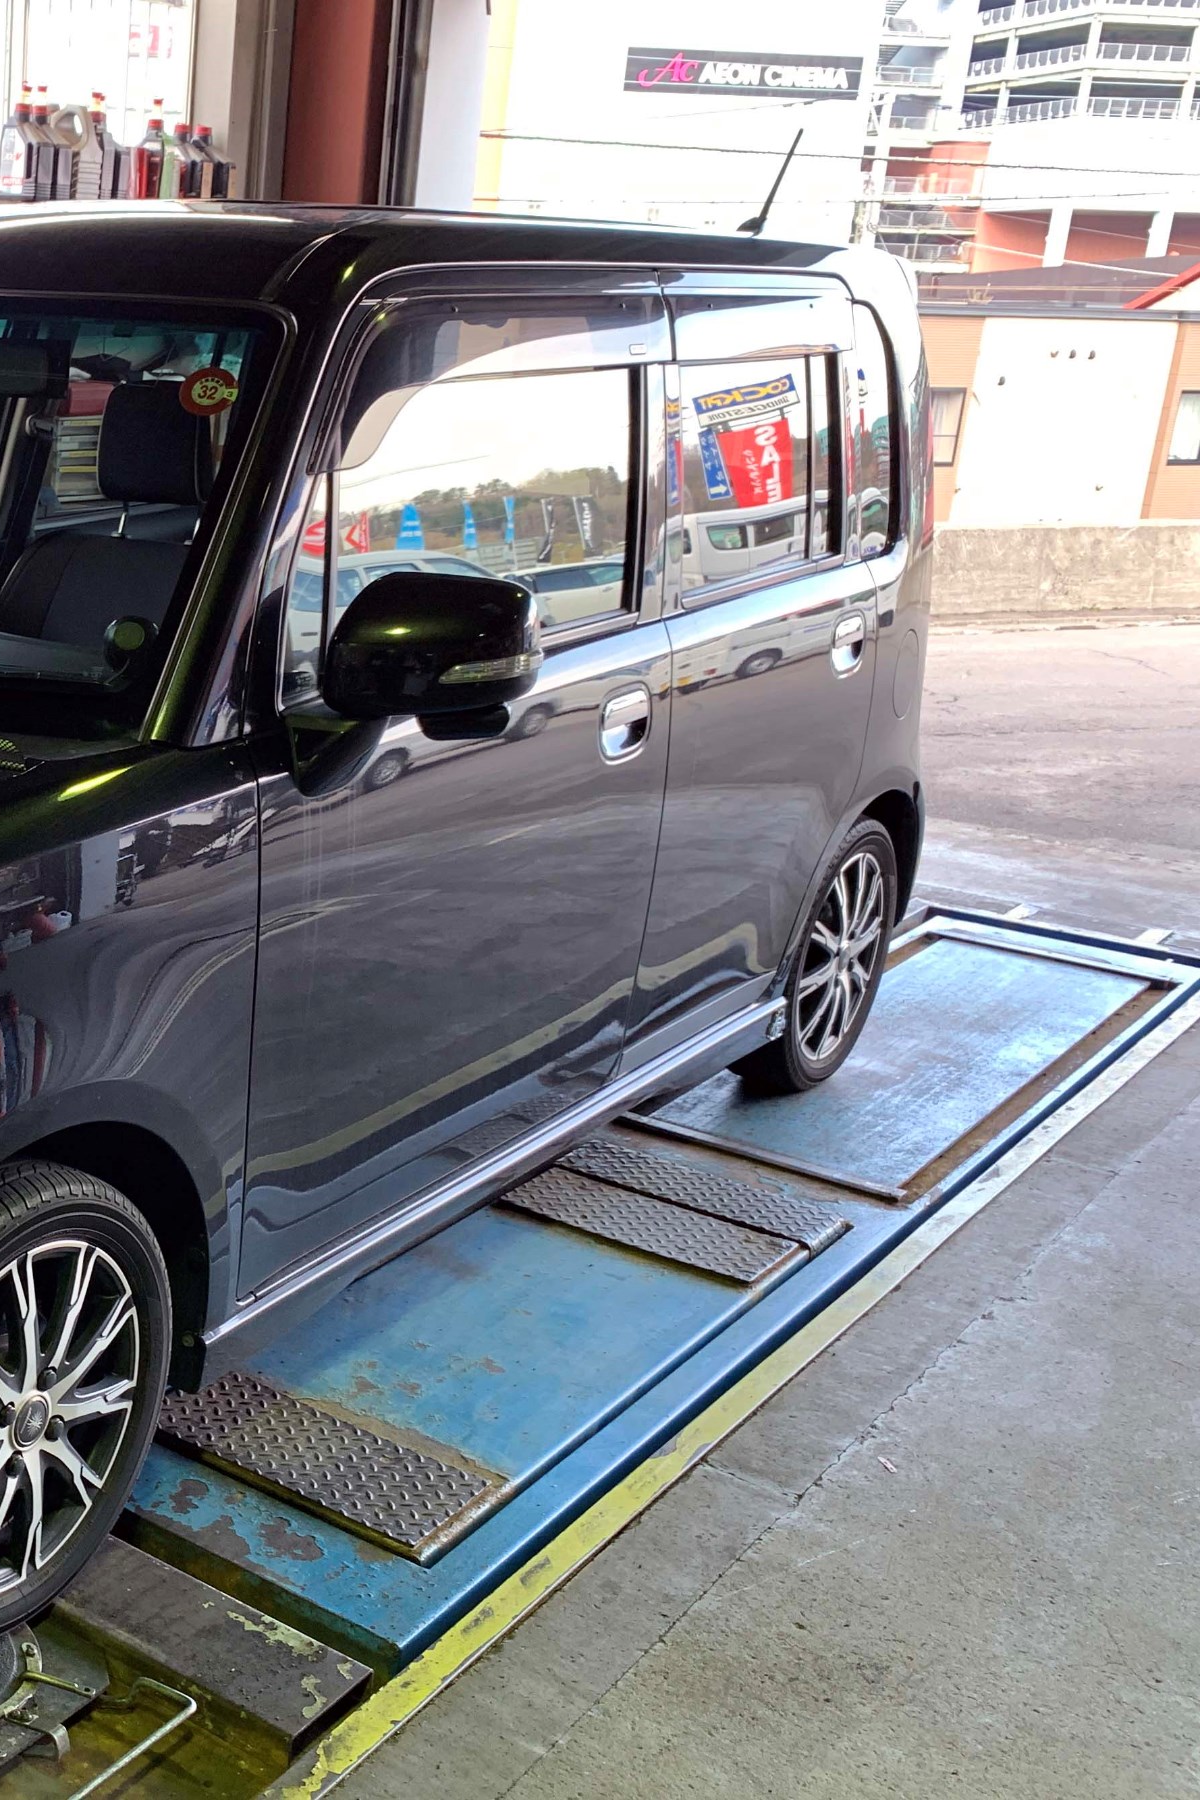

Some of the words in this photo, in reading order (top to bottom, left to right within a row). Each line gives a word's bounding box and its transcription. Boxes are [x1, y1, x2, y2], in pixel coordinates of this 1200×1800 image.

[699, 62, 762, 85] AEON
[764, 65, 849, 89] CINEMA
[197, 385, 216, 399] 32
